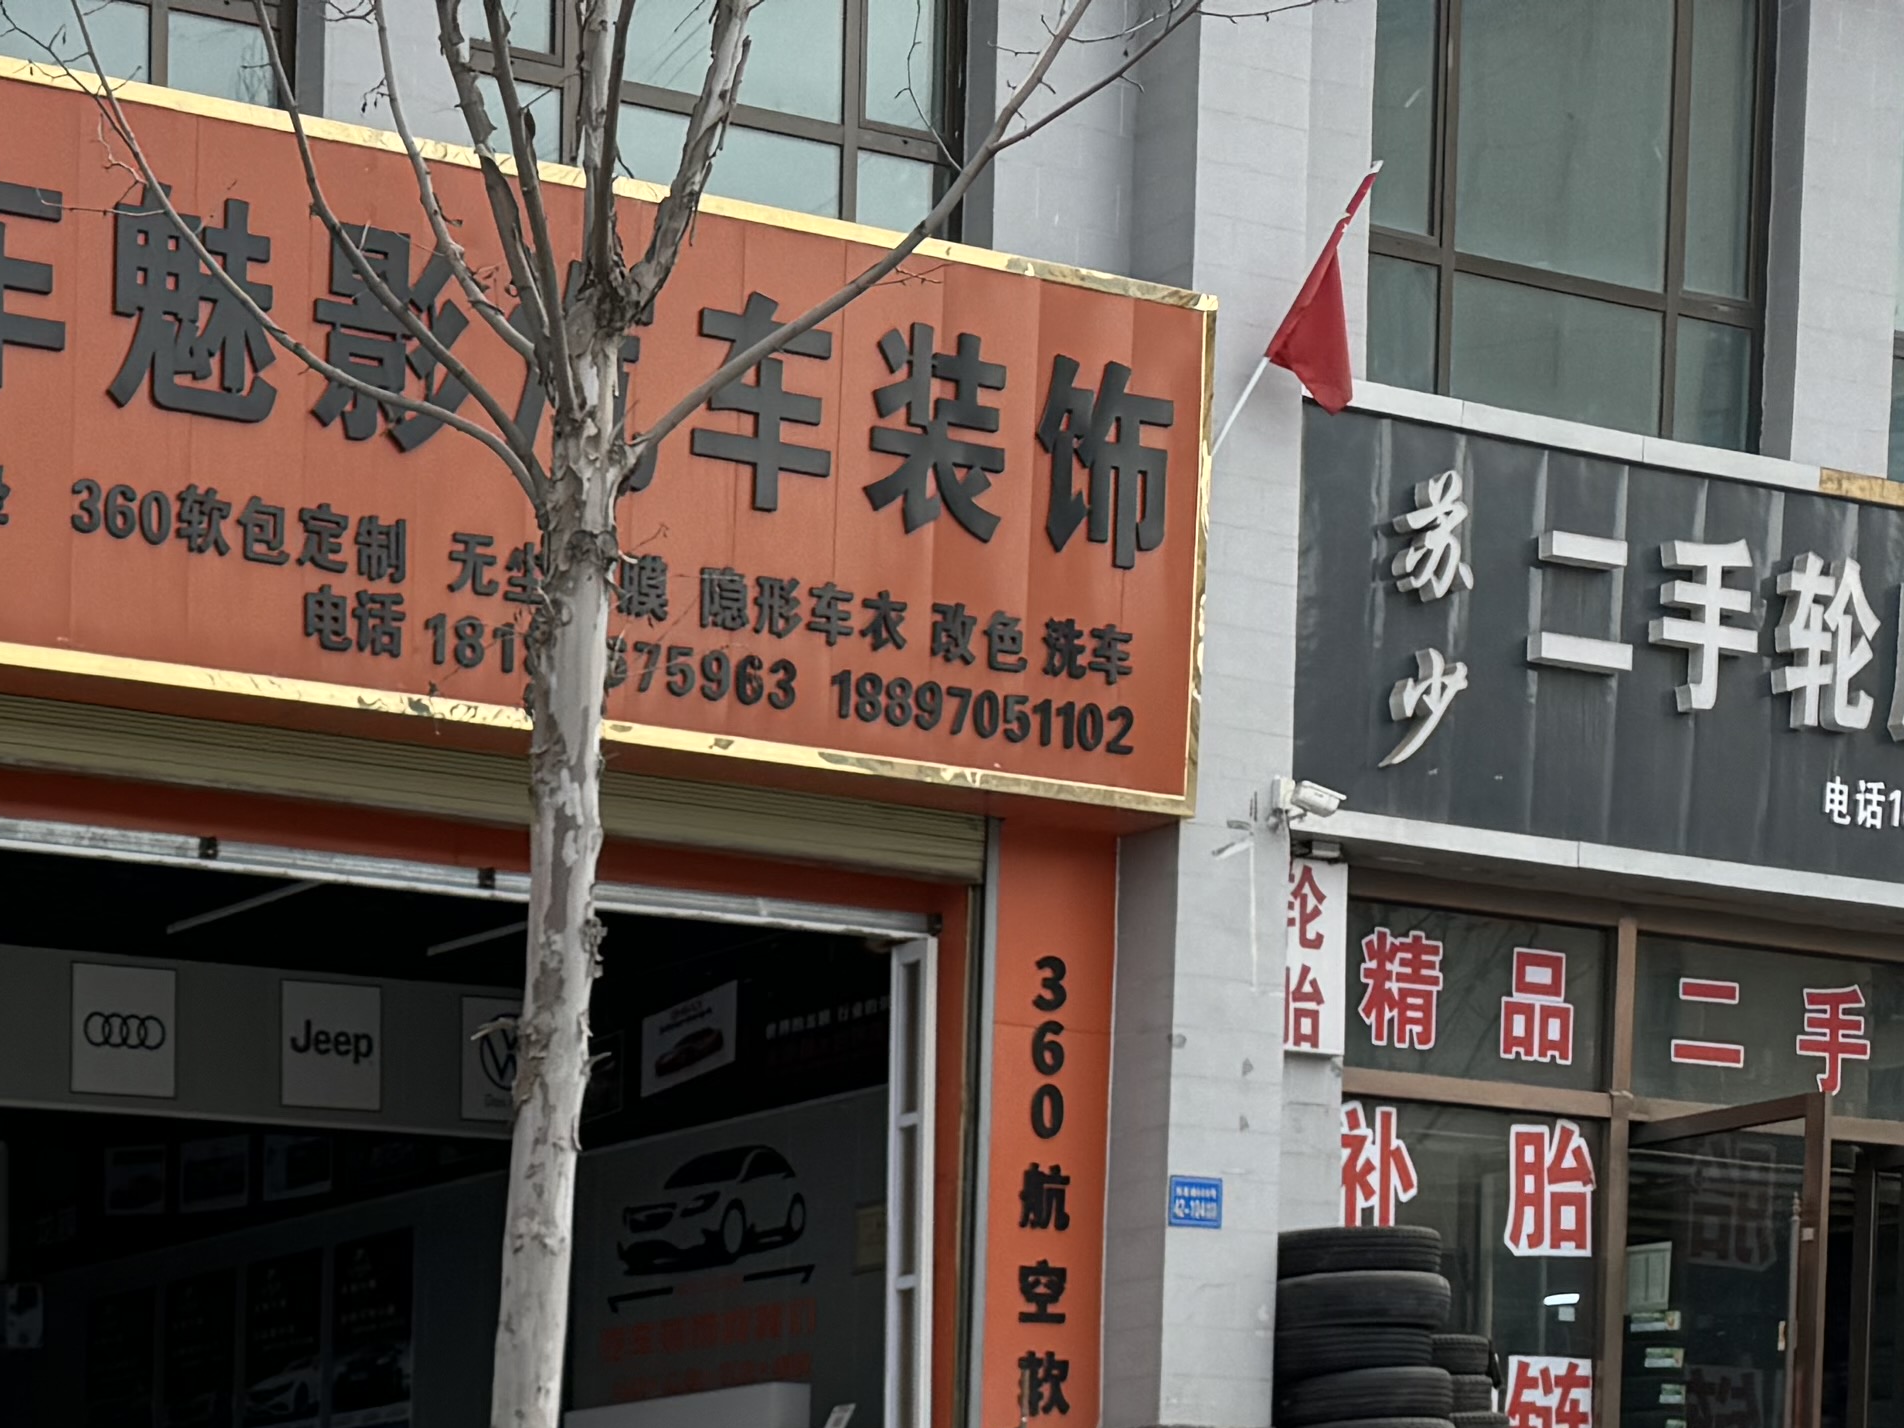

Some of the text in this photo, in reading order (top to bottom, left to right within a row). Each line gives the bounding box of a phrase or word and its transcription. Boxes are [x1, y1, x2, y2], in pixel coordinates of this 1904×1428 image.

[71, 478, 406, 584] 360软包定制
[448, 532, 669, 623] 无尘膜
[699, 566, 908, 650] 隐形车衣
[1527, 530, 1904, 742] 二手轮
[832, 669, 1135, 756] 18897051102
[290, 1019, 374, 1066] Jeep
